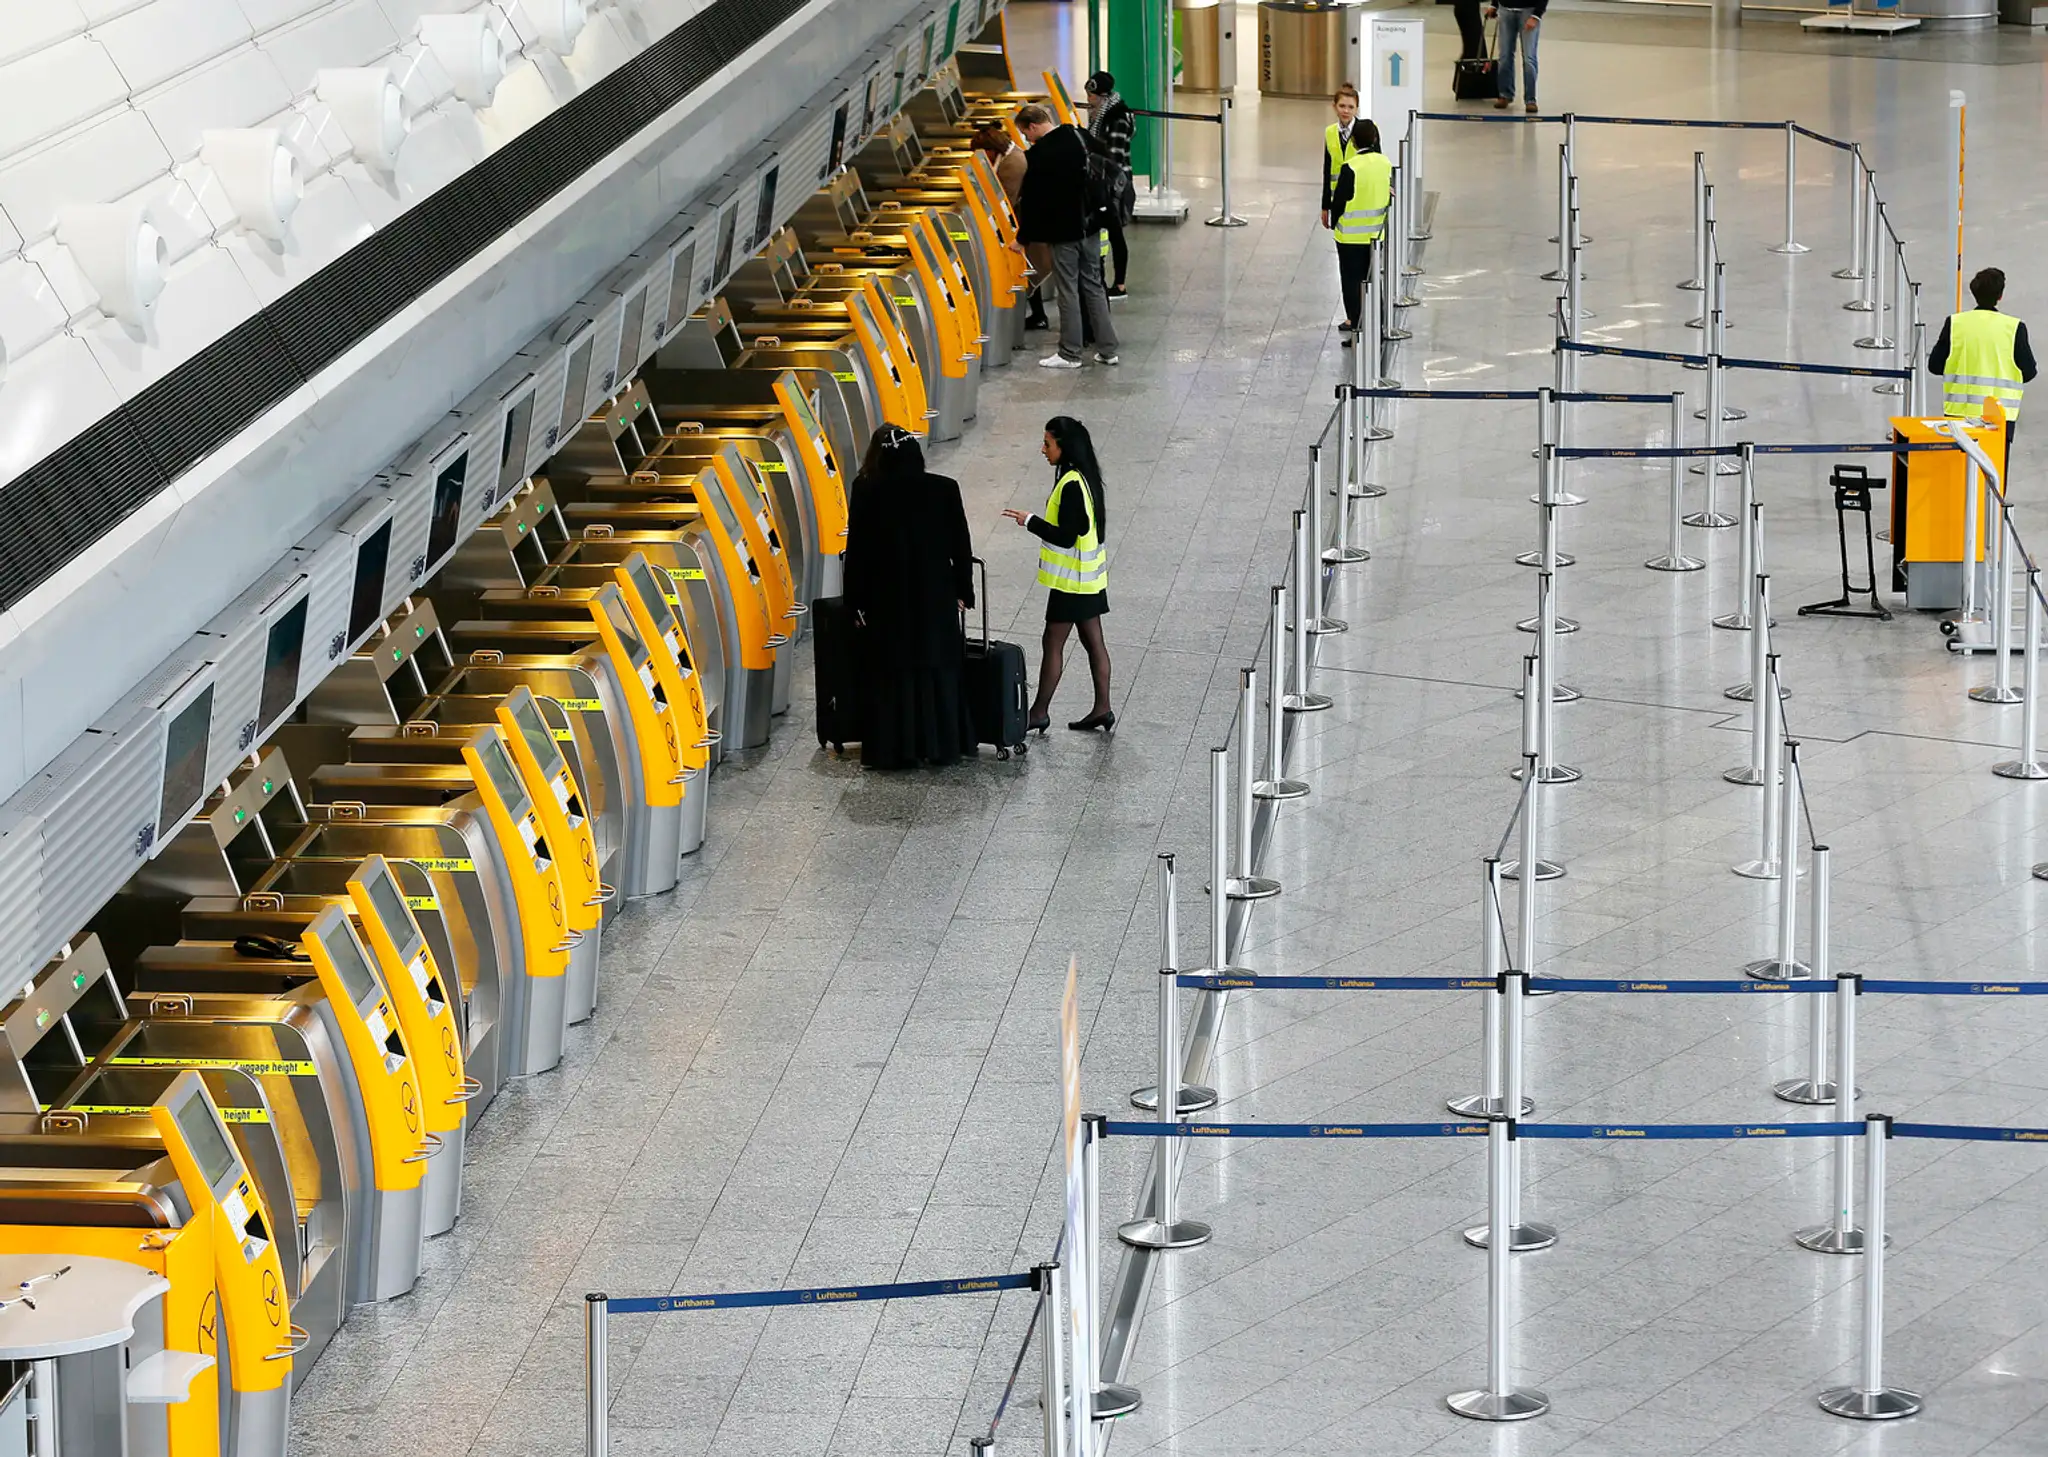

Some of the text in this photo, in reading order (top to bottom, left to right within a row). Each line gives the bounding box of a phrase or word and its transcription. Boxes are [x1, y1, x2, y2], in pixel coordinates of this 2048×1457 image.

[1263, 33, 1272, 81] waste
[1218, 979, 1497, 988] Lufthansa Lufthansa Lufthansa
[1631, 983, 1791, 991] Lufthansa Lufthansa
[1983, 985, 2021, 993] Lufthansa
[272, 1062, 298, 1074] height
[223, 1109, 251, 1122] height
[1191, 1126, 1231, 1134] Lufthansa
[1323, 1127, 1363, 1135] Lufthansa
[1606, 1127, 1787, 1137] Lufthansa Lufthansa
[673, 1280, 999, 1309] Lufthansa Lufthansa Lufthansa
